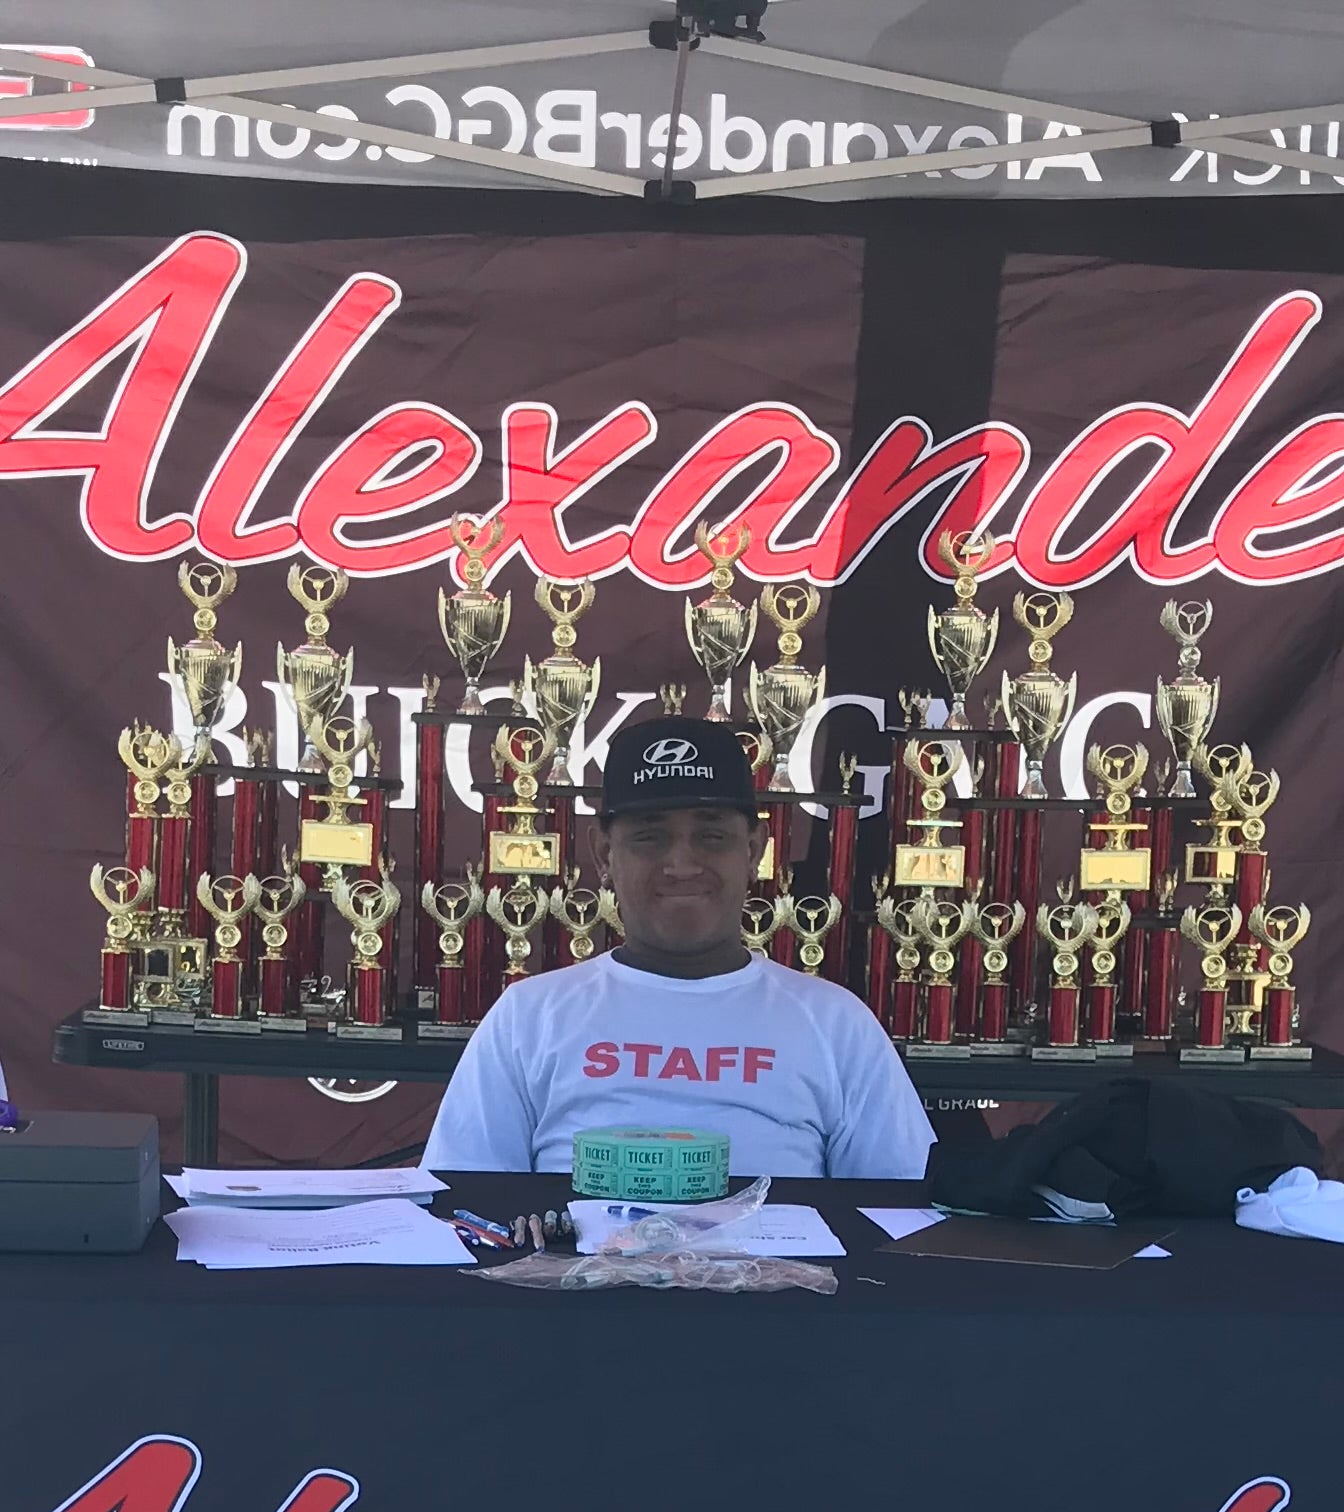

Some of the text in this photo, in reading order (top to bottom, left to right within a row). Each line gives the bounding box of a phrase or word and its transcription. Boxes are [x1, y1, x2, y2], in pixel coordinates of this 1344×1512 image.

[787, 691, 1152, 821] GC
[633, 765, 714, 785] HYUNDAI
[582, 1041, 776, 1084] STAFF
[585, 1146, 610, 1162] TICKET
[628, 1151, 664, 1164] TICKET
[682, 1151, 712, 1164] TICKET
[588, 1172, 605, 1180] KEEP
[634, 1176, 657, 1184] KEEP
[687, 1176, 706, 1184] KEEP
[584, 1182, 610, 1193] COUPON
[627, 1187, 663, 1196] COUPON
[681, 1187, 710, 1196] COUPON
